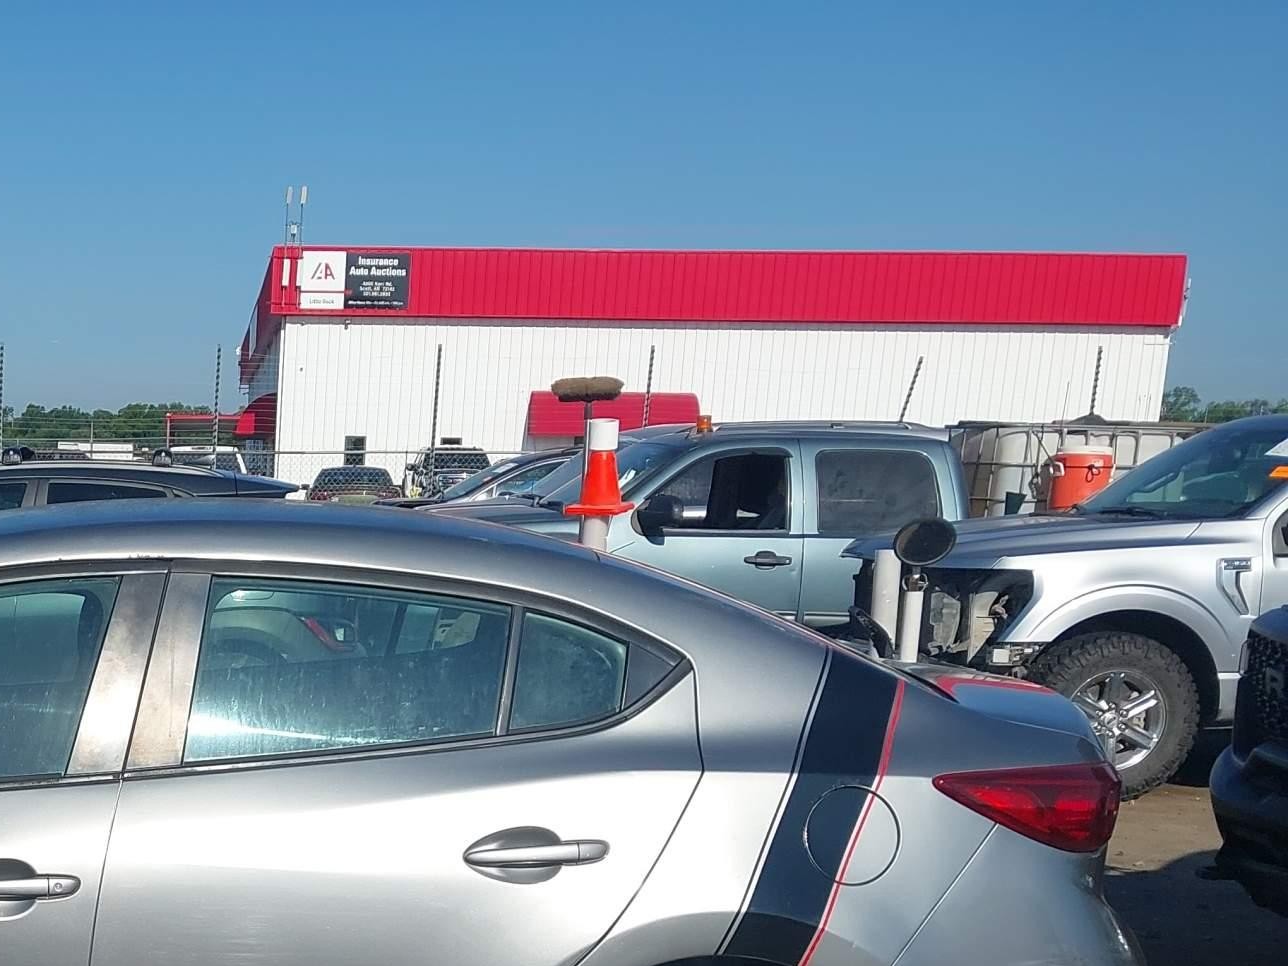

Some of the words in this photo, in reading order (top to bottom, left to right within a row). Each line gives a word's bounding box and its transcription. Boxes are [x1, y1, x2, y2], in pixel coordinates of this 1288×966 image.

[358, 256, 399, 266] Insurance
[349, 266, 369, 276] Auto
[370, 266, 407, 277] Auctions
